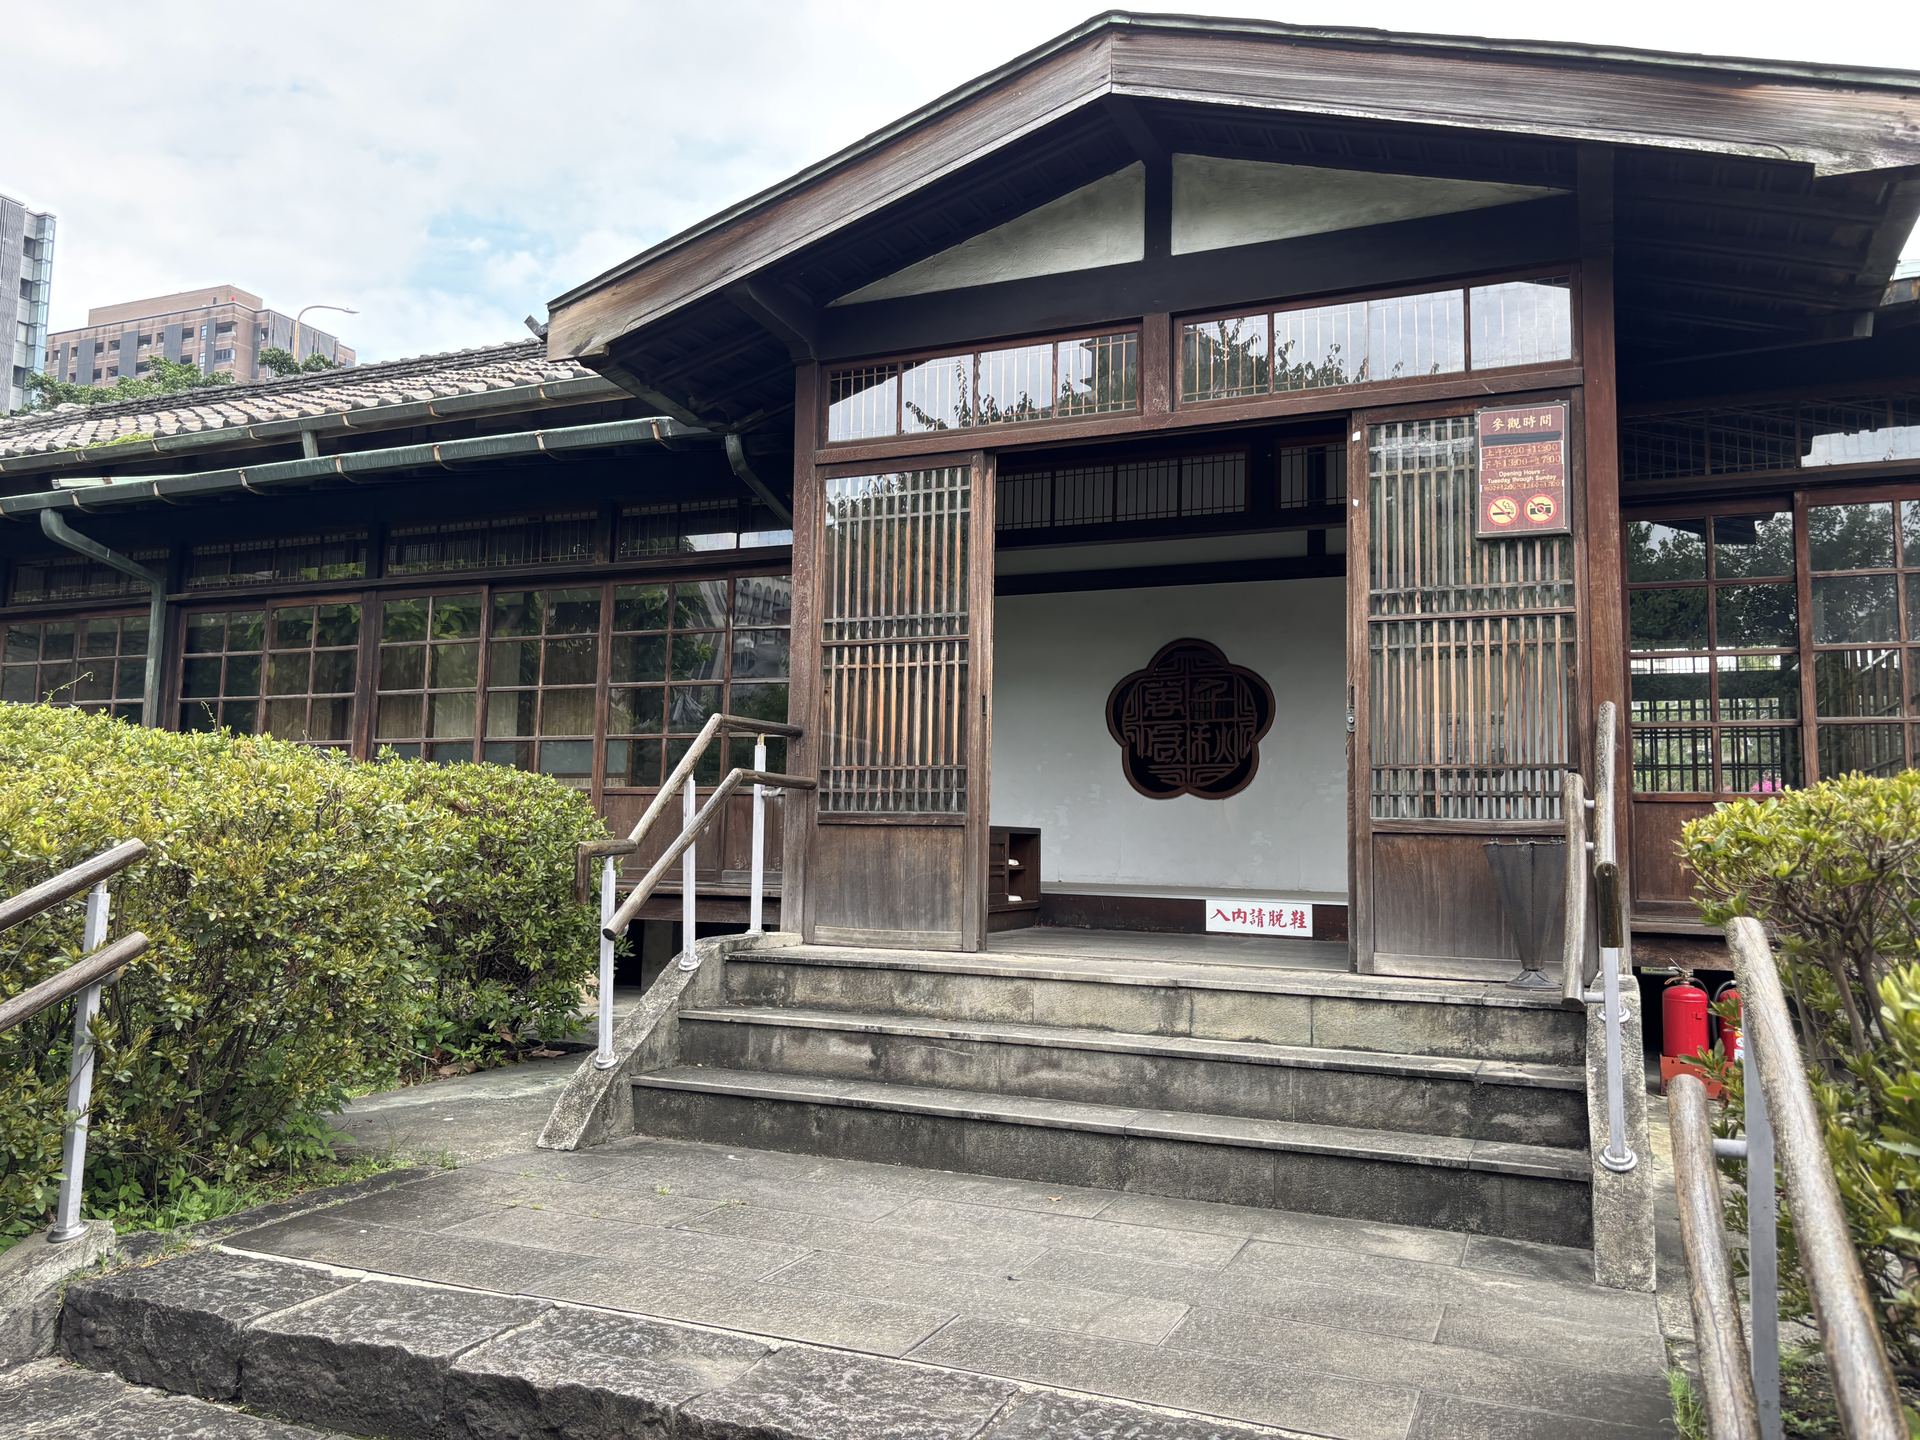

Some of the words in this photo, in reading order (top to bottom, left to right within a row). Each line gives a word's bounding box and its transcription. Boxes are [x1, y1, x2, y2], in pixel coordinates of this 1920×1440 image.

[1492, 414, 1551, 431] 參觀時間
[1498, 470, 1522, 478] Opening
